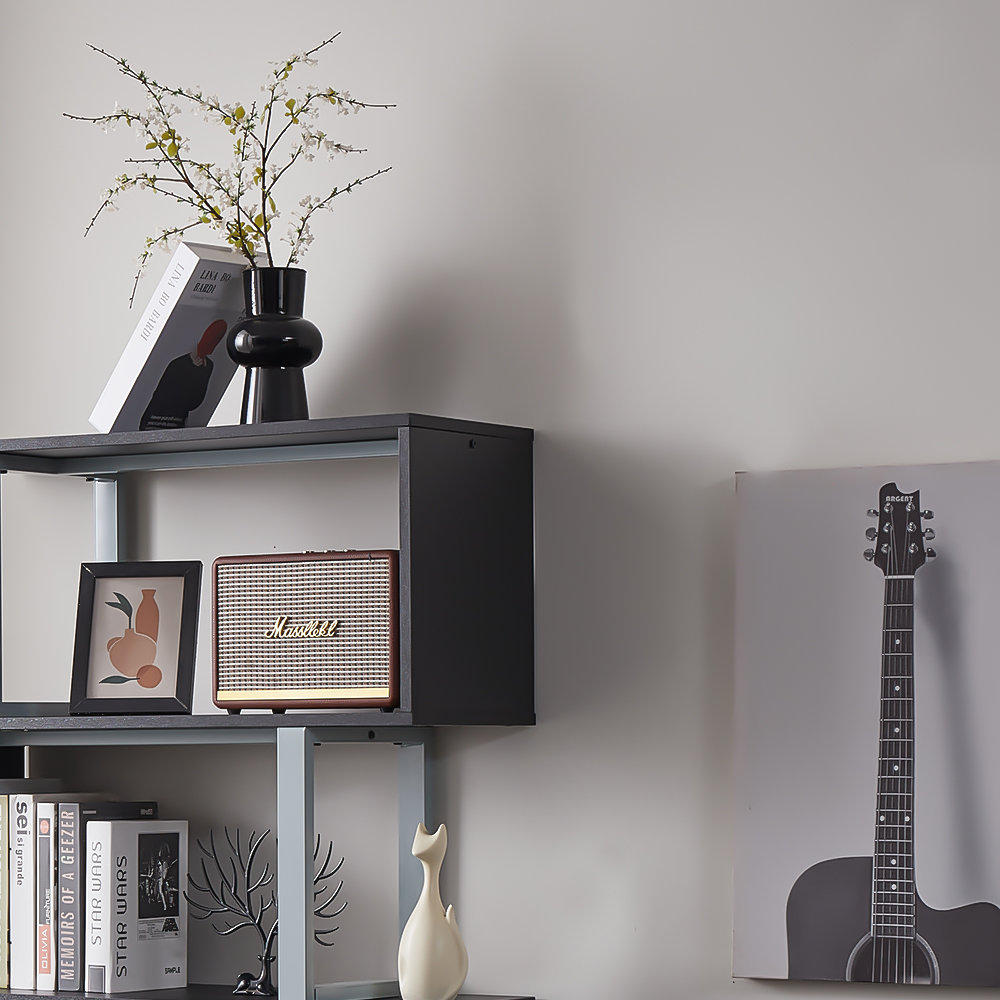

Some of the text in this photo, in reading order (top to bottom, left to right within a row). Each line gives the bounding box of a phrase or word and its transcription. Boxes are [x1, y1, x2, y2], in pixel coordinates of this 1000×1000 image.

[140, 263, 185, 341] LINA BO BARDI
[200, 269, 232, 282] LINA BO
[16, 801, 31, 835] sei
[15, 849, 25, 886] grande
[60, 810, 75, 981] MEMOIRS OF A GEEZER
[91, 841, 102, 946] STAR WARS
[116, 855, 128, 978] STAR WARS
